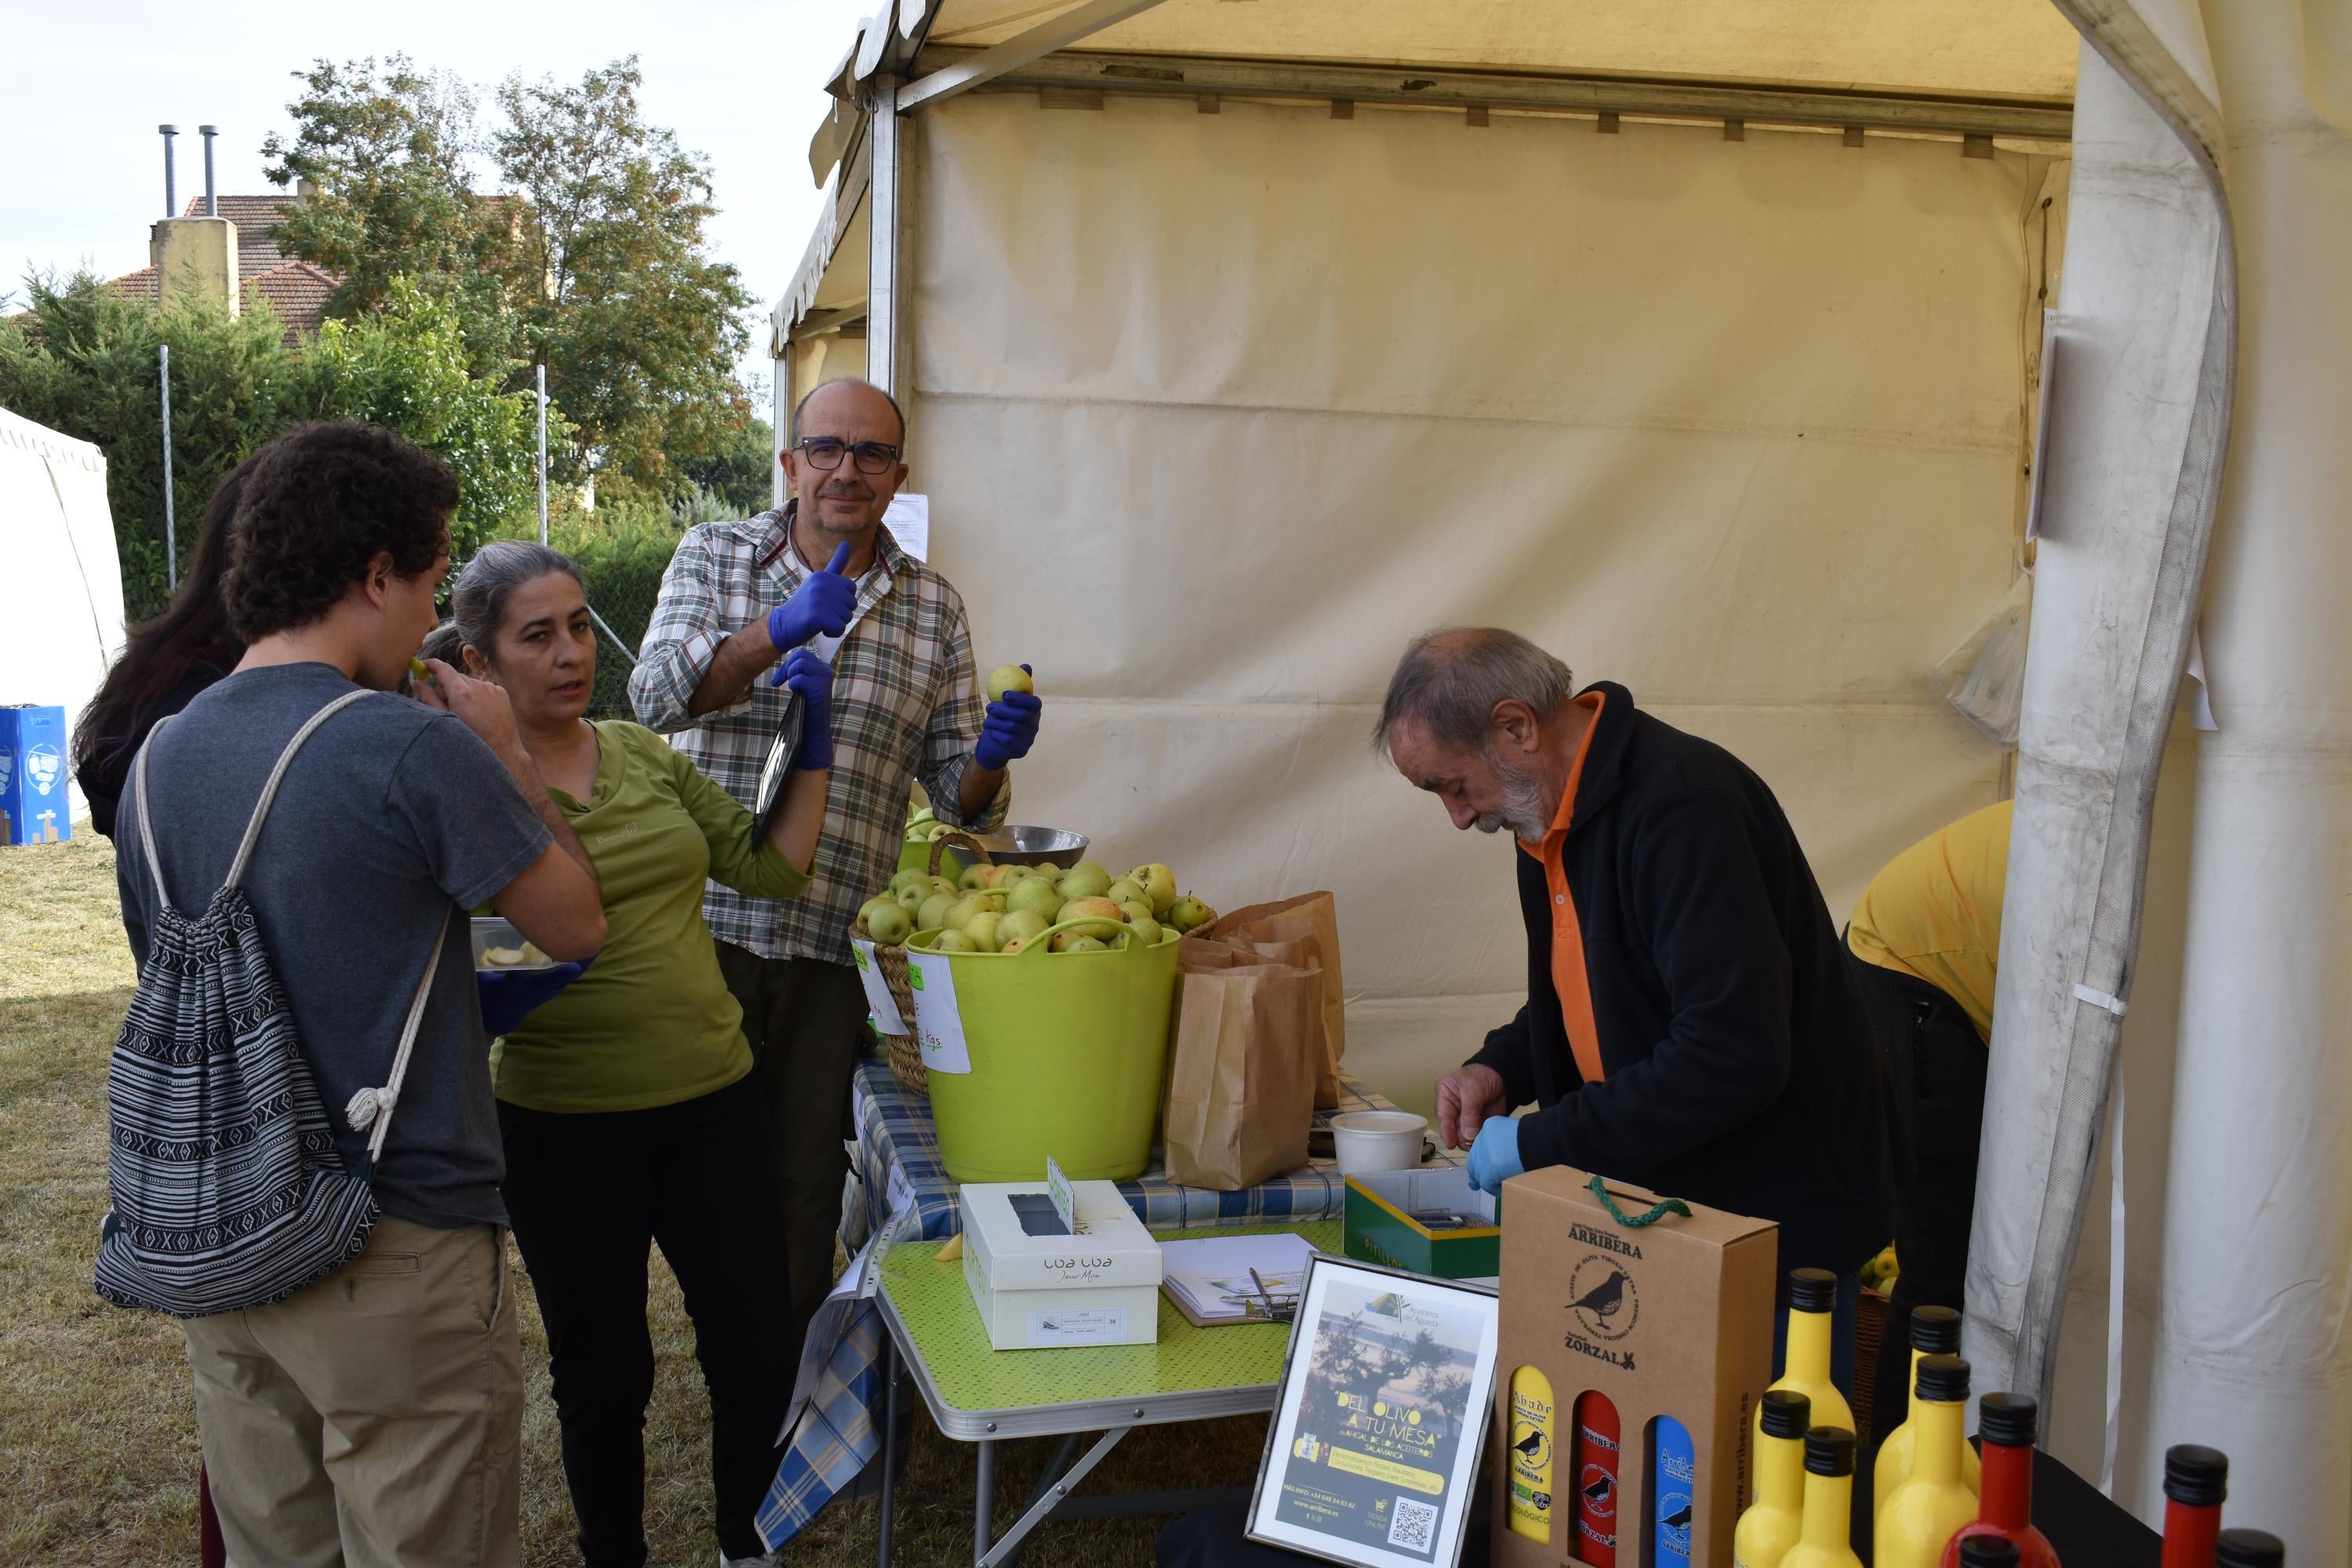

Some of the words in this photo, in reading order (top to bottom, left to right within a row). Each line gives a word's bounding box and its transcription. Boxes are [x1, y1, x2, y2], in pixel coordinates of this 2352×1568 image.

[1364, 1238, 1403, 1269] PITILLOS
[1568, 1226, 1643, 1260] ARRIBERA
[1582, 1254, 1599, 1264] OLIVA
[1600, 1255, 1624, 1271] VIRGEN
[1410, 1305, 1439, 1319] Aceiteros
[1628, 1299, 1639, 1330] PREMIUM
[1603, 1329, 1629, 1341] COSECHA
[1565, 1336, 1620, 1365] ZORZAL
[1512, 1389, 1552, 1413] Abade
[1347, 1412, 1358, 1428] A
[1366, 1416, 1385, 1434] TU
[1374, 1401, 1421, 1425] OLIVO
[1345, 1429, 1369, 1442] AHIGAL
[1370, 1436, 1380, 1444] DE
[1381, 1439, 1395, 1448] LOS
[1396, 1443, 1434, 1458] ACEITEROS
[1364, 1443, 1404, 1461] SALAMANCA
[1515, 1465, 1544, 1483] ARRIBERA
[1294, 1499, 1339, 1517] www.arribera.es
